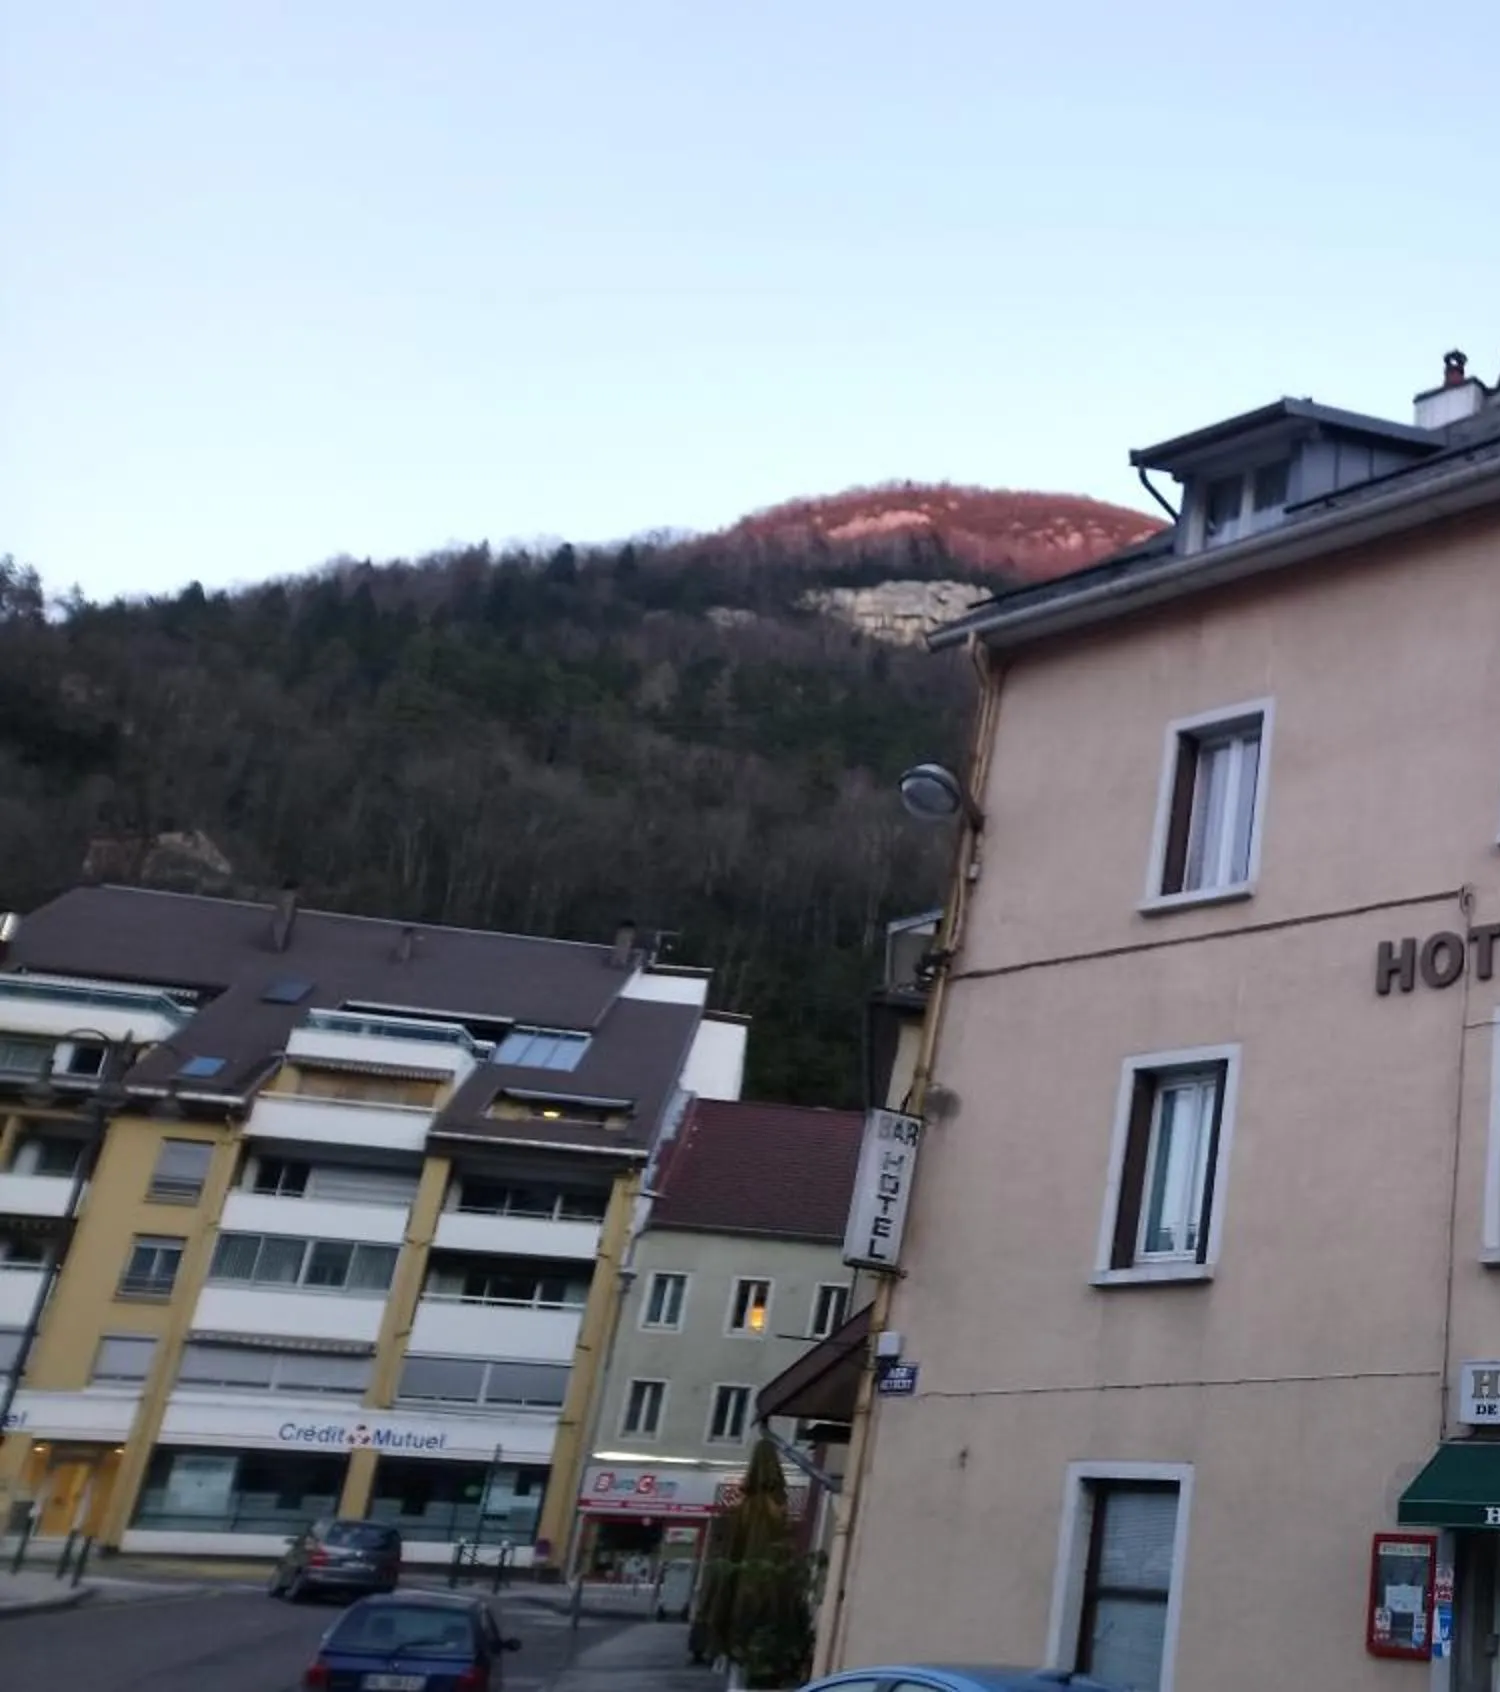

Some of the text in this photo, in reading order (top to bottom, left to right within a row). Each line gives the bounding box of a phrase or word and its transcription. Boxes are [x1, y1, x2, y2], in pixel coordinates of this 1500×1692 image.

[878, 1114, 920, 1147] BAR
[867, 1151, 906, 1260] HOTEL
[1475, 1404, 1498, 1416] DE
[278, 1422, 448, 1450] Crédit Mutuel
